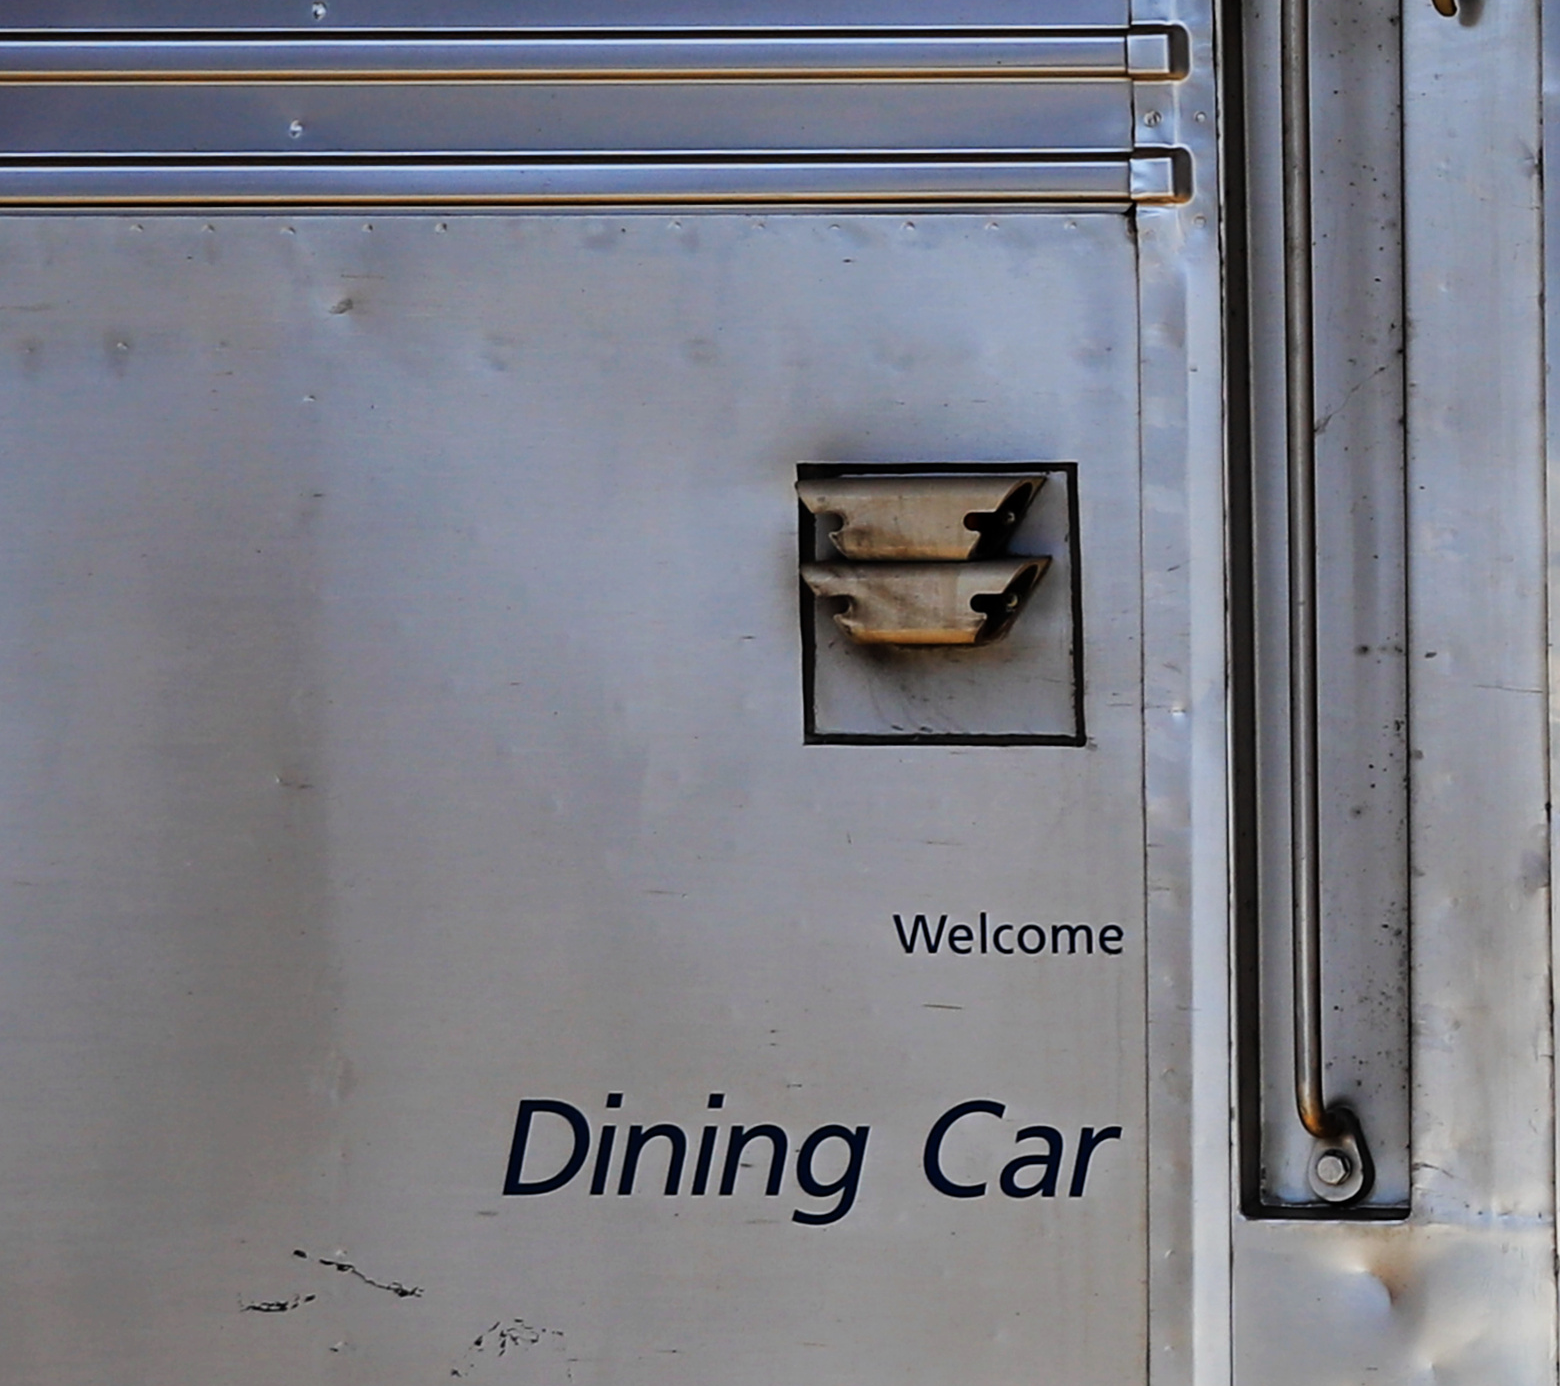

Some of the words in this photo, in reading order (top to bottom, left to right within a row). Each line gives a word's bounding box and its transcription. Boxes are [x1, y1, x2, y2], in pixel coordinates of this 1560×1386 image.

[892, 912, 1124, 954] Welcome
[502, 1093, 870, 1225] Dining
[923, 1099, 1122, 1198] Car
